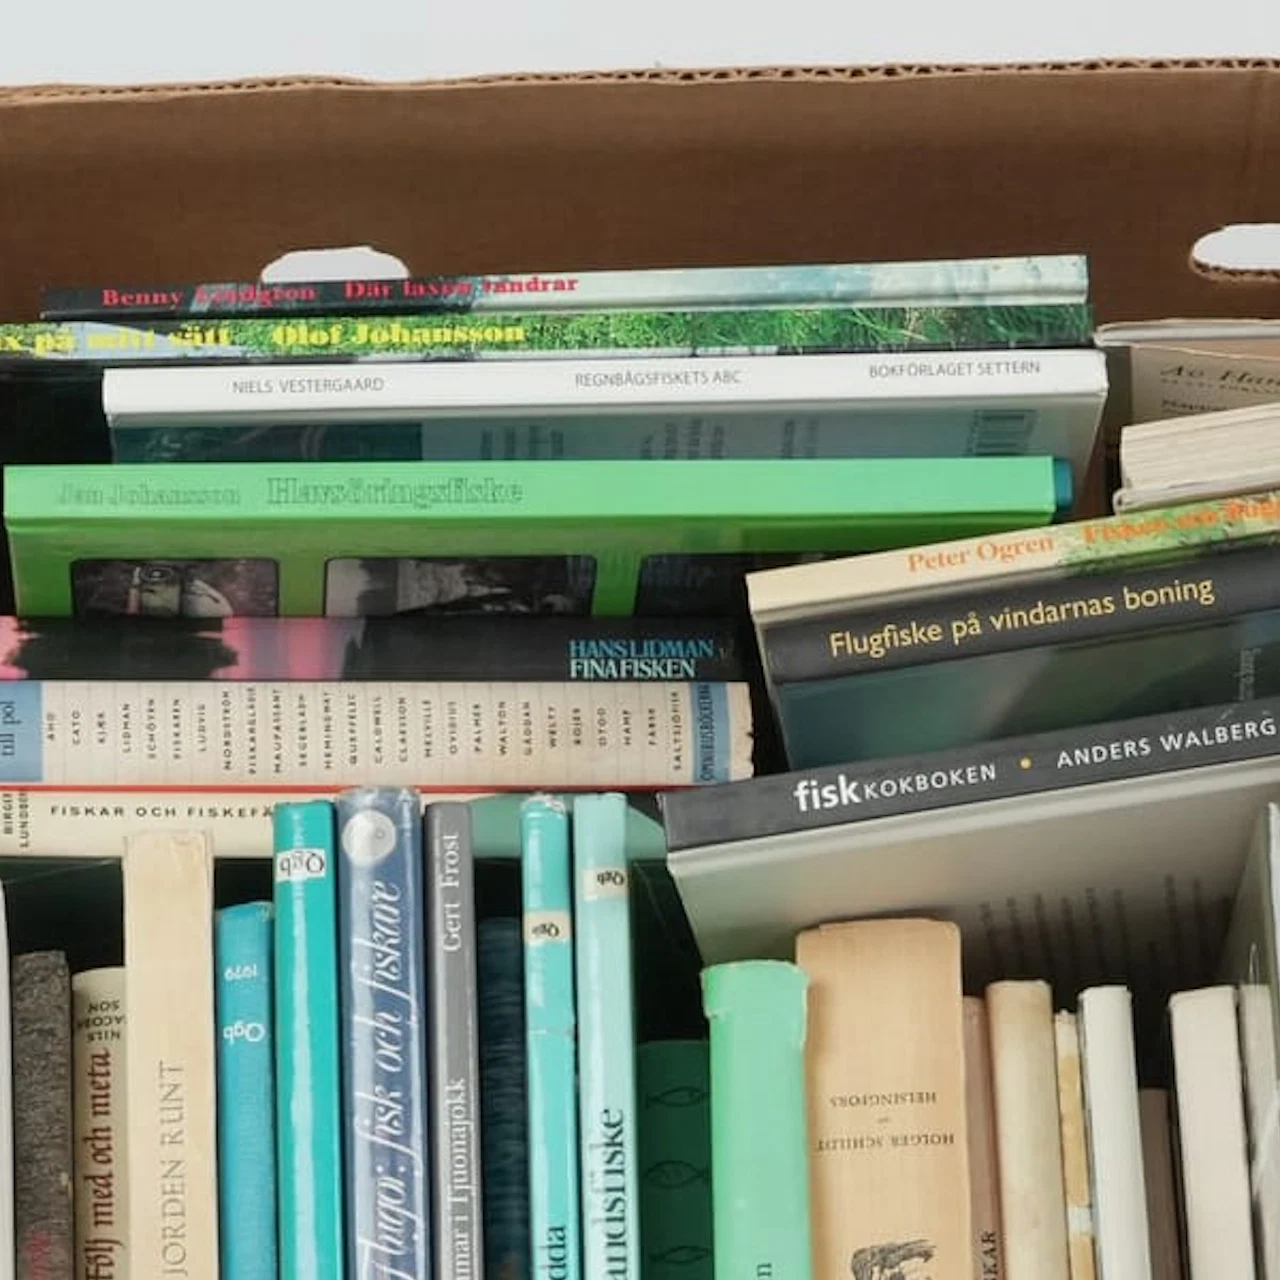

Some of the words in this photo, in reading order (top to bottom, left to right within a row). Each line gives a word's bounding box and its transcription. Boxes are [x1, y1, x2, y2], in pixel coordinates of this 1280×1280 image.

[102, 287, 182, 308] Benny
[32, 325, 77, 355] på
[272, 325, 342, 346] Olof
[349, 323, 526, 346] Johansson
[233, 378, 273, 394] NIELS
[279, 377, 385, 393] VESTERGAARD
[575, 368, 711, 388] REGNBÅGSFISKETS
[715, 370, 742, 384] ABC
[869, 359, 974, 379] BOKFÖRLAGET
[978, 360, 1041, 376] SETTERN
[907, 547, 971, 574] Peter
[829, 622, 943, 660] Flugfiske
[952, 611, 983, 646] på
[990, 595, 1115, 635] vindarnas
[1124, 577, 1216, 612] boning
[570, 639, 627, 658] HANS
[629, 639, 715, 658] LIDMAN
[570, 659, 618, 679] FINA
[620, 658, 696, 679] FISKEN
[71, 710, 81, 745] CATO
[121, 702, 132, 753] LIDMAN
[1057, 737, 1152, 769] ANDERS
[1160, 717, 1278, 755] WALBERG
[50, 806, 124, 818] FISKAR
[135, 805, 177, 818] OCH
[438, 833, 462, 889] Frost
[350, 881, 412, 1001] fiskare
[440, 901, 463, 953] Gert
[350, 1010, 402, 1073] och
[84, 1046, 112, 1117] meta
[158, 1059, 185, 1146] RUNT
[829, 1091, 938, 1108] HELSINGFORS
[80, 1125, 113, 1165] och
[353, 1086, 420, 1161] fisk
[890, 1132, 955, 1148] HOLGER
[83, 1173, 114, 1227] med
[159, 1158, 189, 1277] JORDEN
